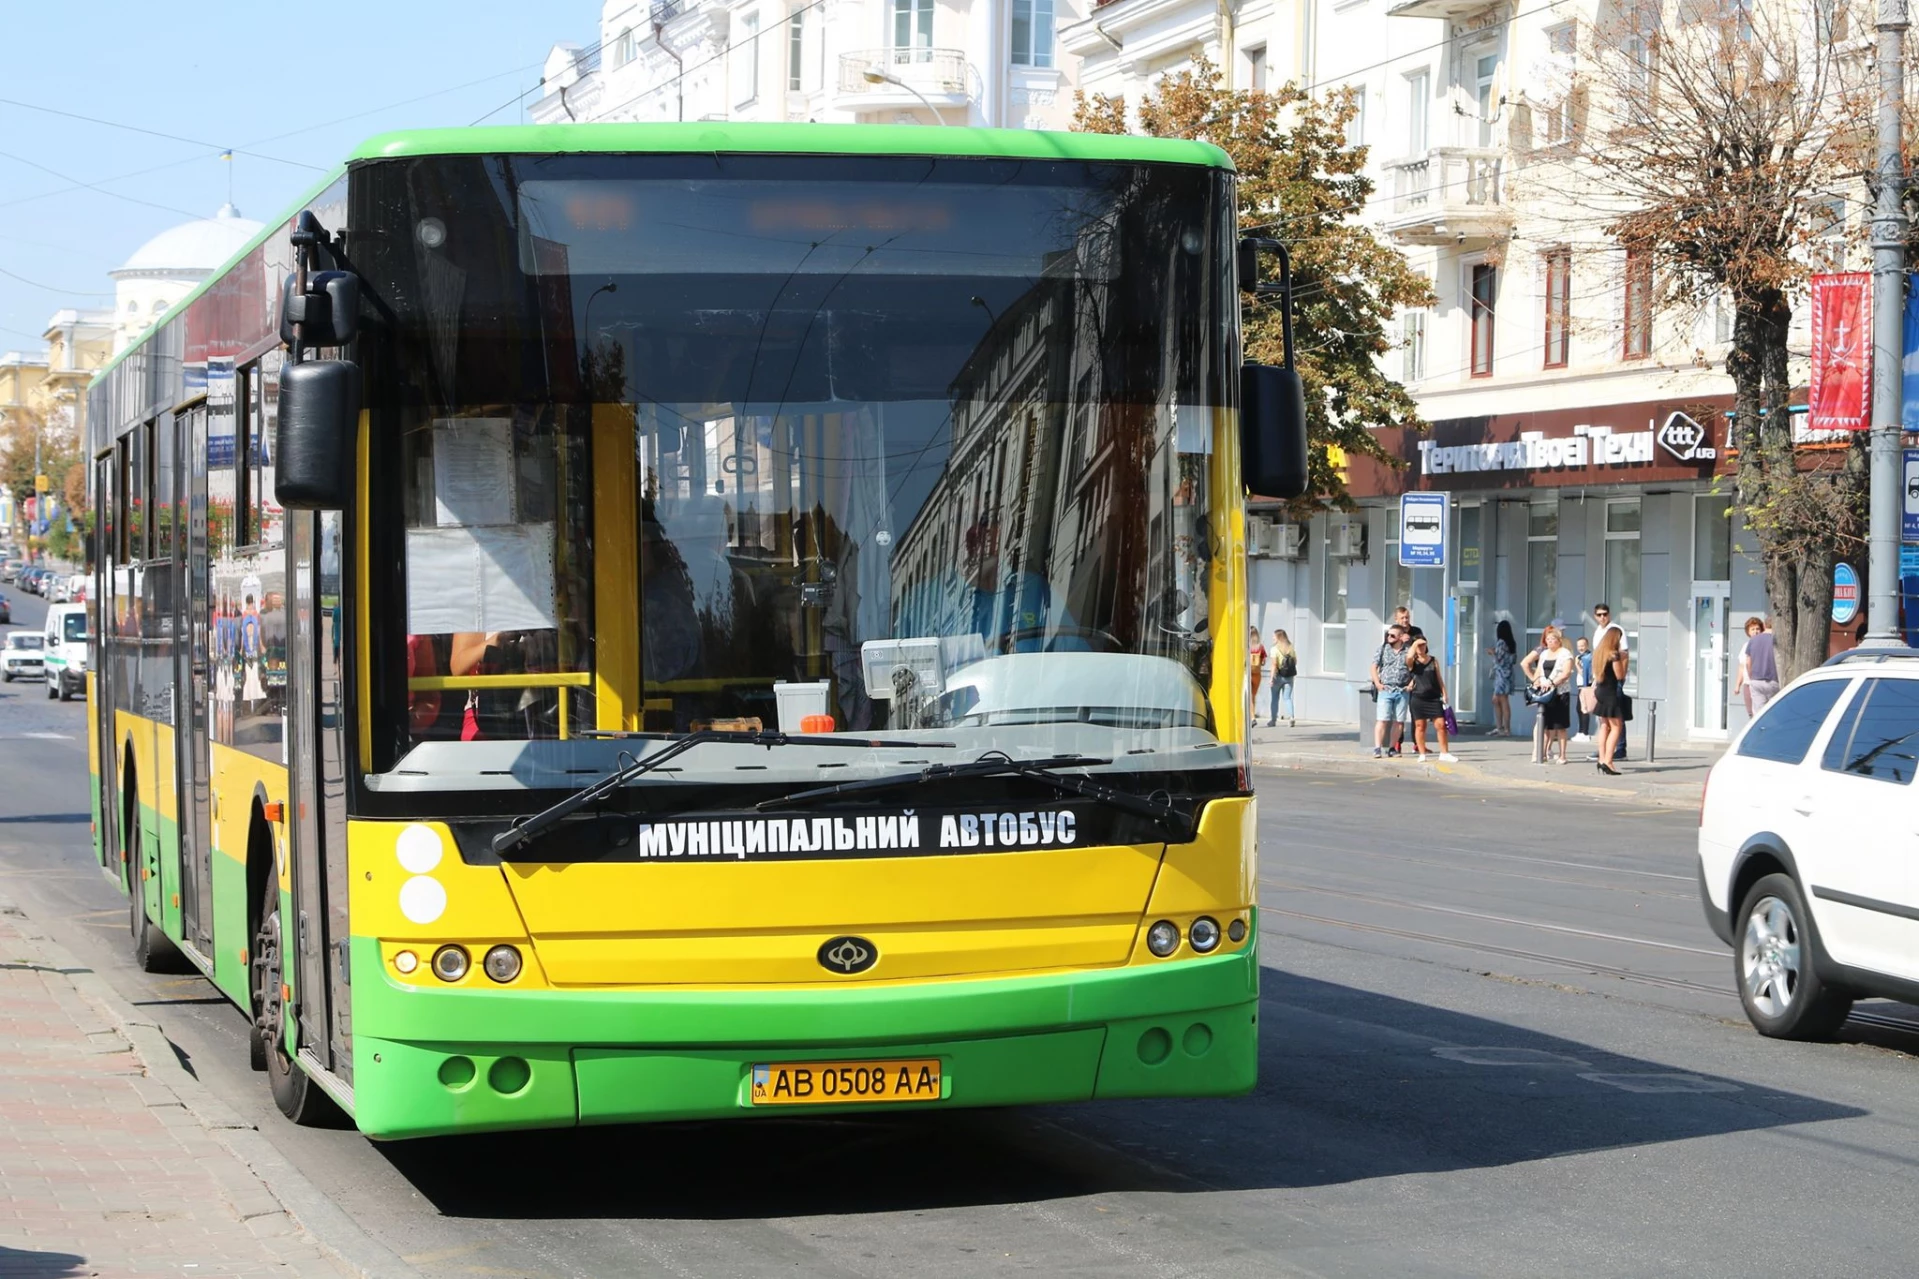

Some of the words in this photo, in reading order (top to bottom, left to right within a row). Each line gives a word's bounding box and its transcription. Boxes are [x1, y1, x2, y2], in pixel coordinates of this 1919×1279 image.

[1667, 426, 1695, 445] ttt
[639, 809, 920, 859] МУНІЦИПАЛЬНИЙ
[939, 810, 1077, 848] АВТОБУС
[754, 1089, 767, 1098] UA
[773, 1069, 814, 1098] AB
[822, 1067, 886, 1096] 0508
[894, 1066, 934, 1095] AA
